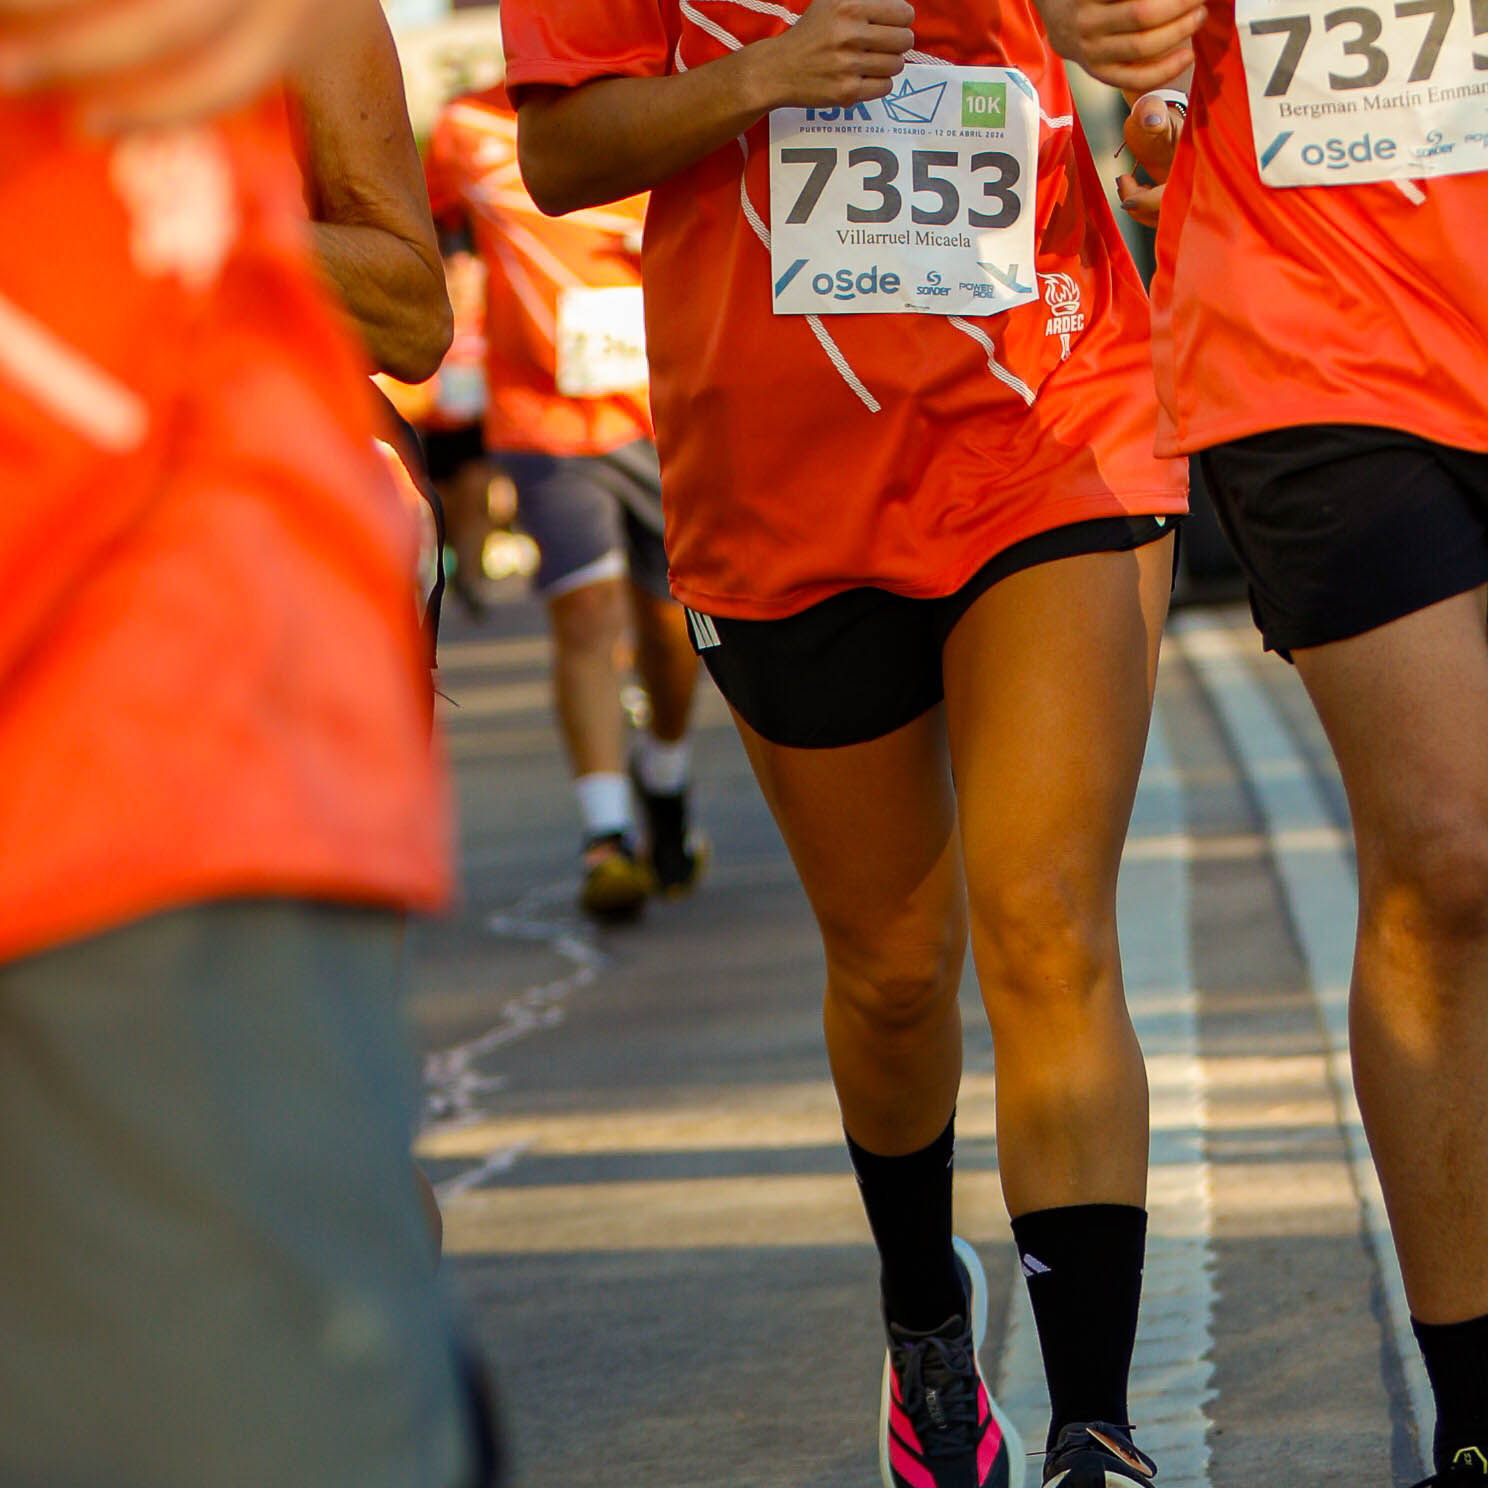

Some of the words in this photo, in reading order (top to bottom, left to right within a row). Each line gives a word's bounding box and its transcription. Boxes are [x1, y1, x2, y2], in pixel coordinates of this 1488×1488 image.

[966, 95, 1001, 114] 10K
[1279, 100, 1358, 118] Bergman
[780, 145, 1022, 229] 7353
[836, 230, 911, 246] Villarruel
[915, 230, 971, 248] Micaela
[1045, 313, 1085, 337] ARDEC
